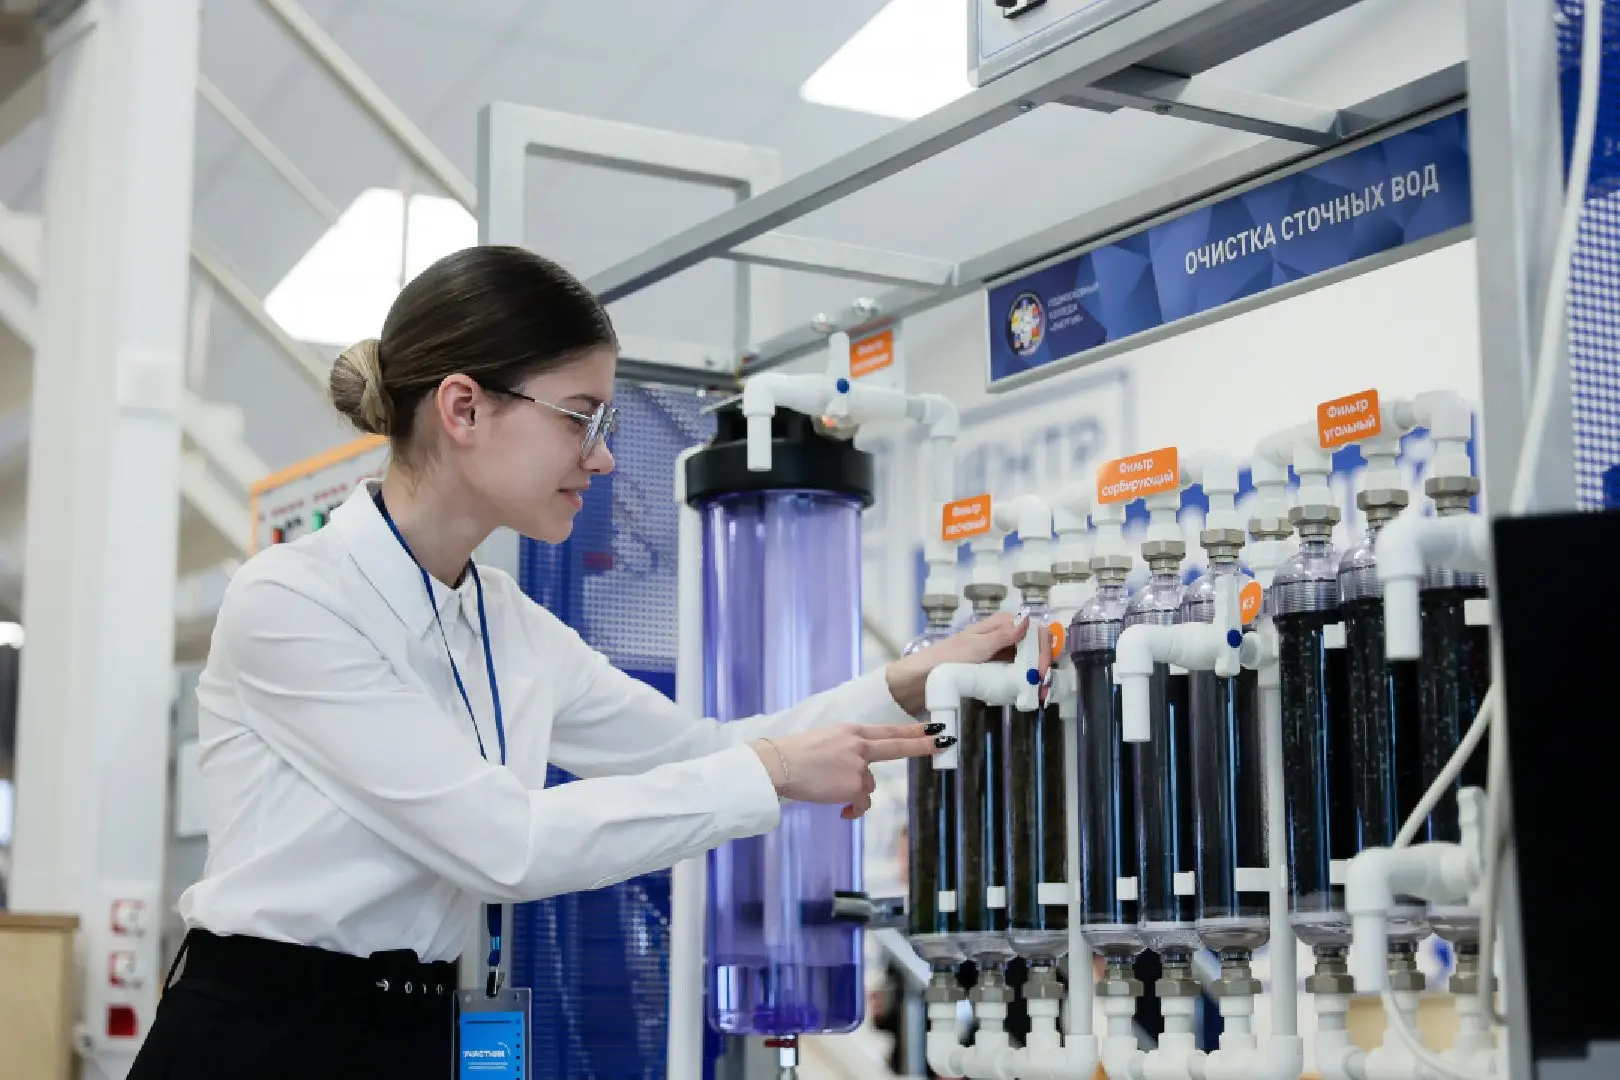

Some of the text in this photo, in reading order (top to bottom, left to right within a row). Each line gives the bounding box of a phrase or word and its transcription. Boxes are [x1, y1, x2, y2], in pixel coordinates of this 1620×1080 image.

[1185, 163, 1440, 275] ОЧИСТКА СТОЧНЫХ ВОД
[1327, 399, 1369, 418] Фильтр
[1323, 414, 1376, 443] угольный
[1119, 459, 1154, 473] Фильтр
[1101, 469, 1174, 497] сорбирующий
